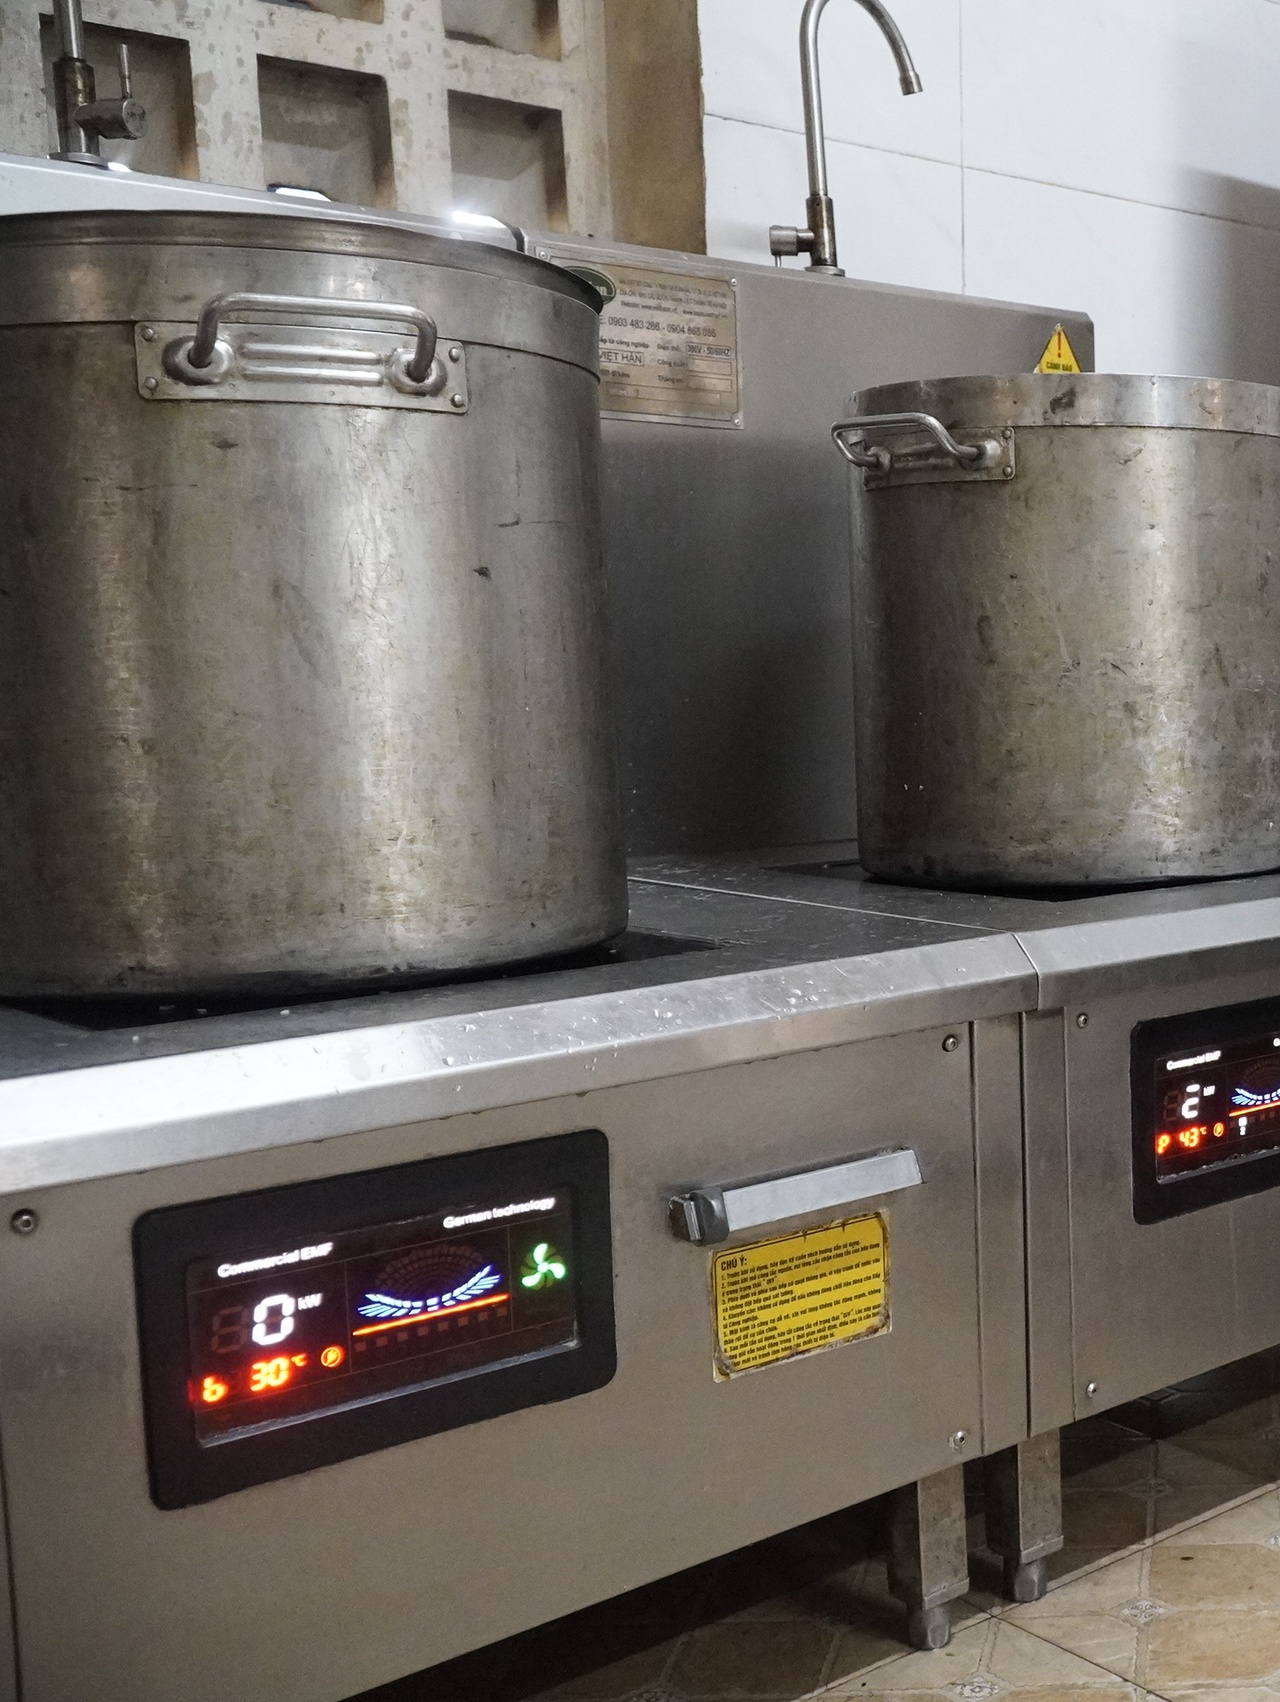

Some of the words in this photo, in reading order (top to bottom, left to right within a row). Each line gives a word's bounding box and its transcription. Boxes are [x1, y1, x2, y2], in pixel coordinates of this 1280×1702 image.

[443, 1210, 492, 1228] German
[493, 1197, 555, 1218] technology
[217, 1250, 299, 1278] Commercial
[300, 1242, 333, 1260] EMF
[720, 1257, 737, 1271] CHÚ
